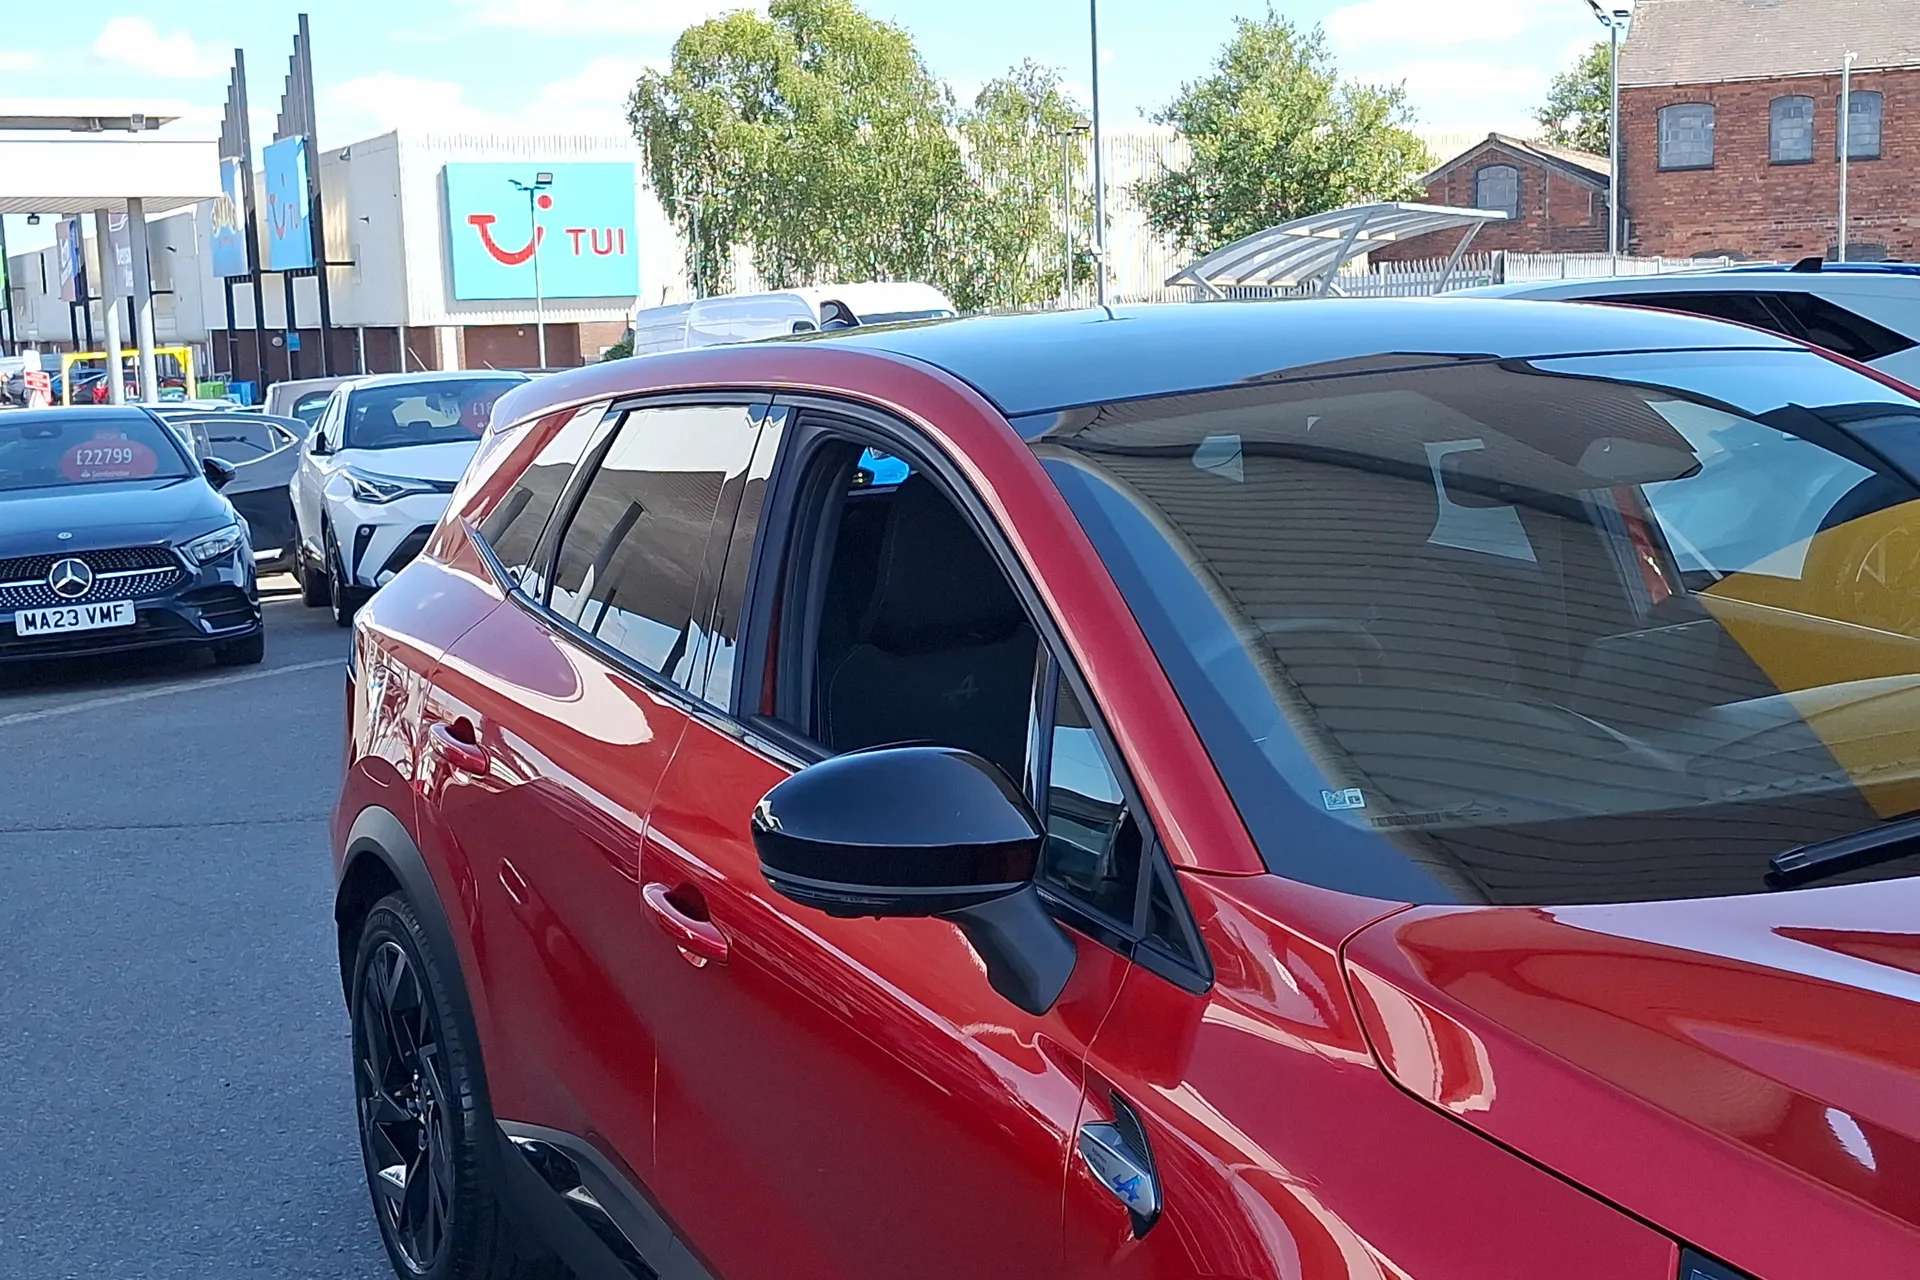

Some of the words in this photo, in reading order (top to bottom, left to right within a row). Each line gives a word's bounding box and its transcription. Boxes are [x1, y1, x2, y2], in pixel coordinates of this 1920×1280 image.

[565, 228, 624, 256] TUI
[76, 448, 132, 465] £22799
[24, 609, 79, 631] MA23
[85, 604, 124, 625] VMF
